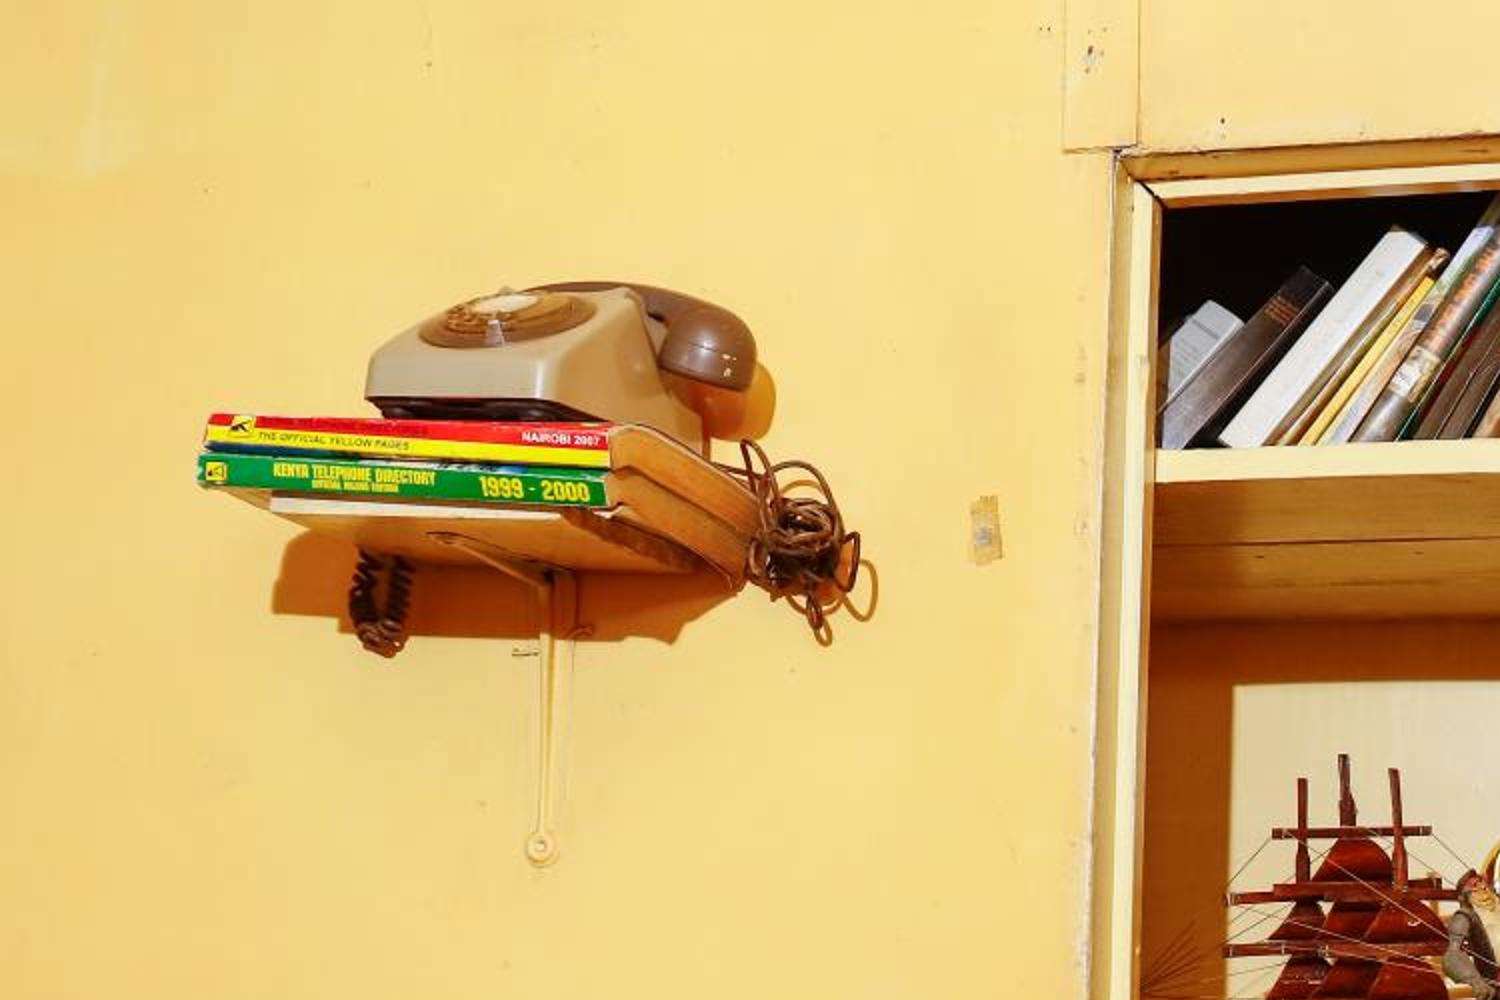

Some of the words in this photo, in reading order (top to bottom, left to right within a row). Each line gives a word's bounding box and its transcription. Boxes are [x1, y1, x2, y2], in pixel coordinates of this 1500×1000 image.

[257, 431, 277, 442] THE
[279, 432, 324, 446] OFFICIAL
[329, 435, 373, 448] YELLOW
[375, 438, 410, 451] PAGES
[521, 431, 571, 446] NAIROBI
[574, 434, 601, 446] 2007
[273, 462, 310, 479] KENYA
[312, 464, 371, 483] TELEPHONE
[374, 466, 437, 486] DIRECTORY
[479, 474, 525, 498] 1999
[540, 478, 591, 501] 2000
